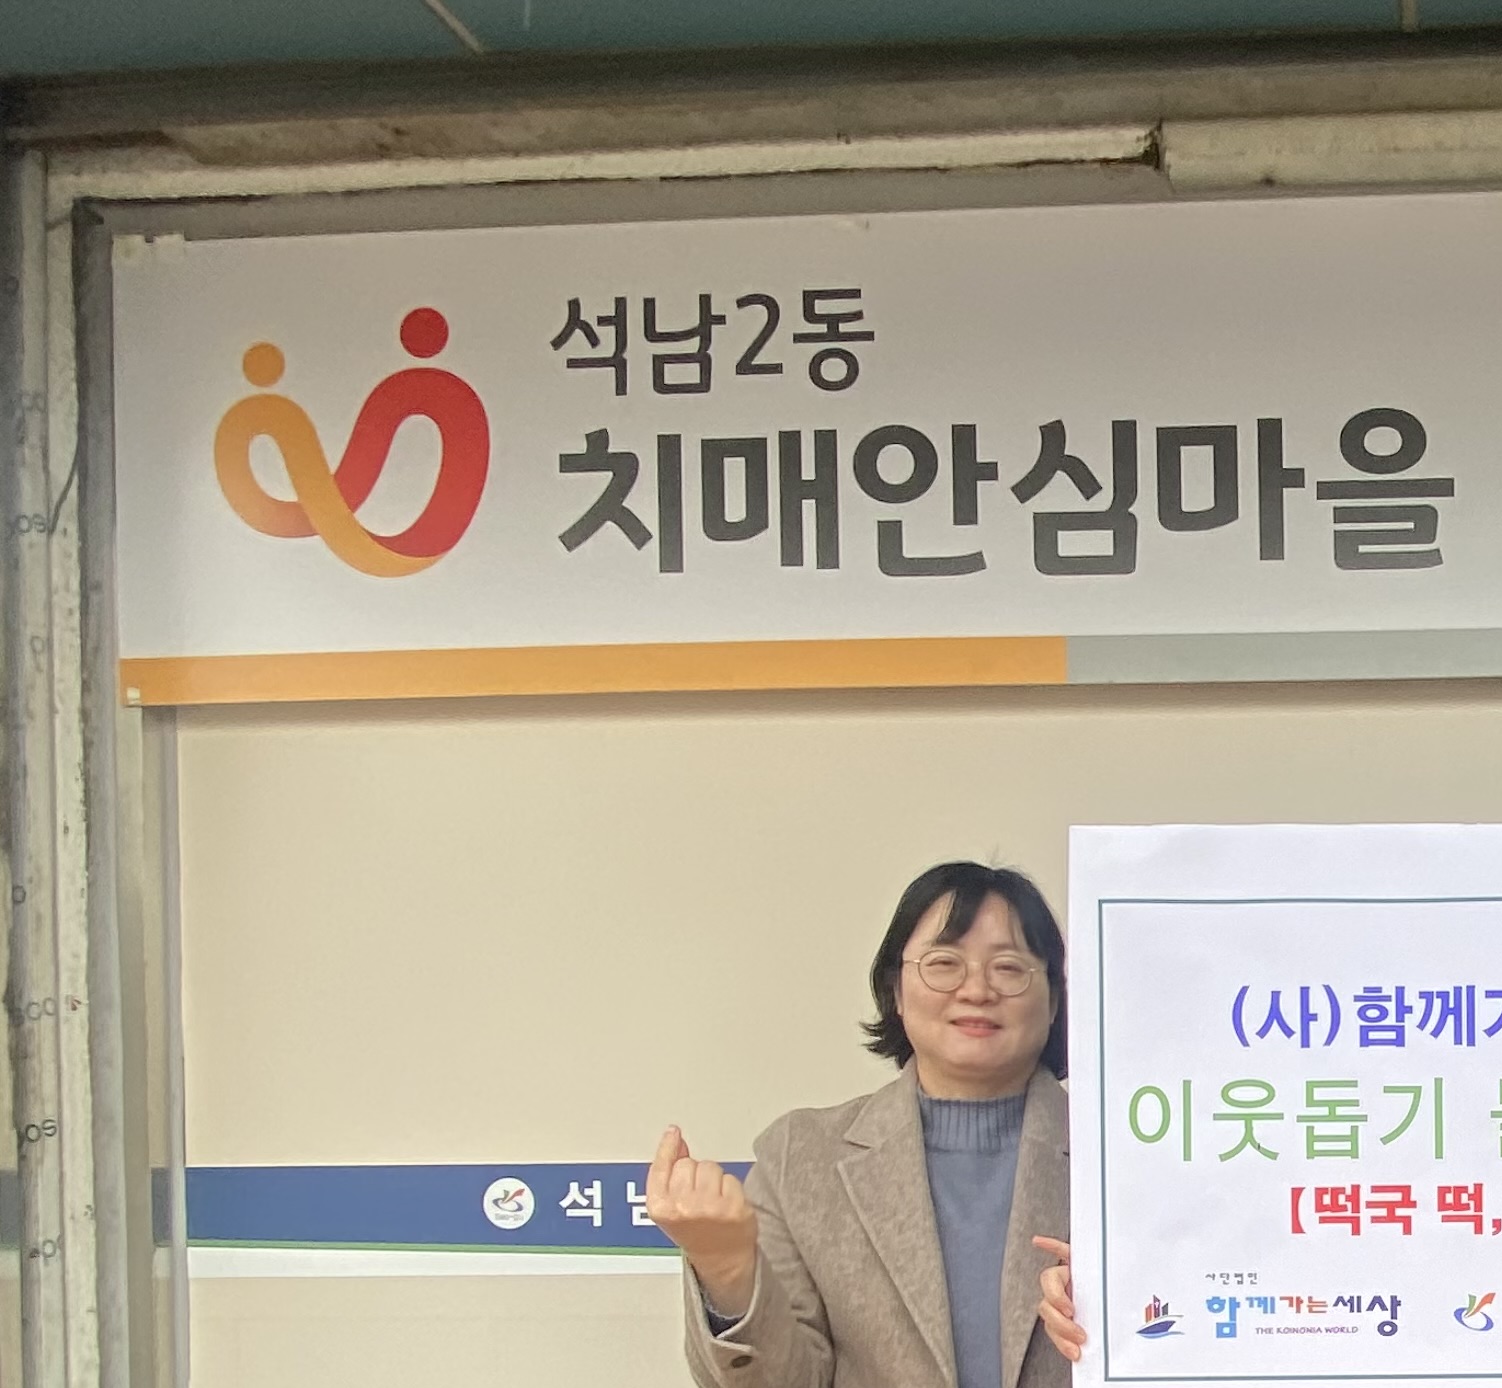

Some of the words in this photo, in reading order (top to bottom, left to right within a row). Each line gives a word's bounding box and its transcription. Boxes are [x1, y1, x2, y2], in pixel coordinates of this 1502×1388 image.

[549, 285, 876, 396] 석남2동
[555, 406, 1456, 577] 치매안심마을
[1127, 1077, 1447, 1162] 이웃돕기
[1437, 1183, 1502, 1236] 떡,
[1205, 1272, 1258, 1286] 사단법인
[1205, 1295, 1401, 1338] 함께가는세상
[1255, 1326, 1274, 1335] THE
[1276, 1326, 1322, 1335] KOINONIA
[1324, 1325, 1359, 1334] WORLD
